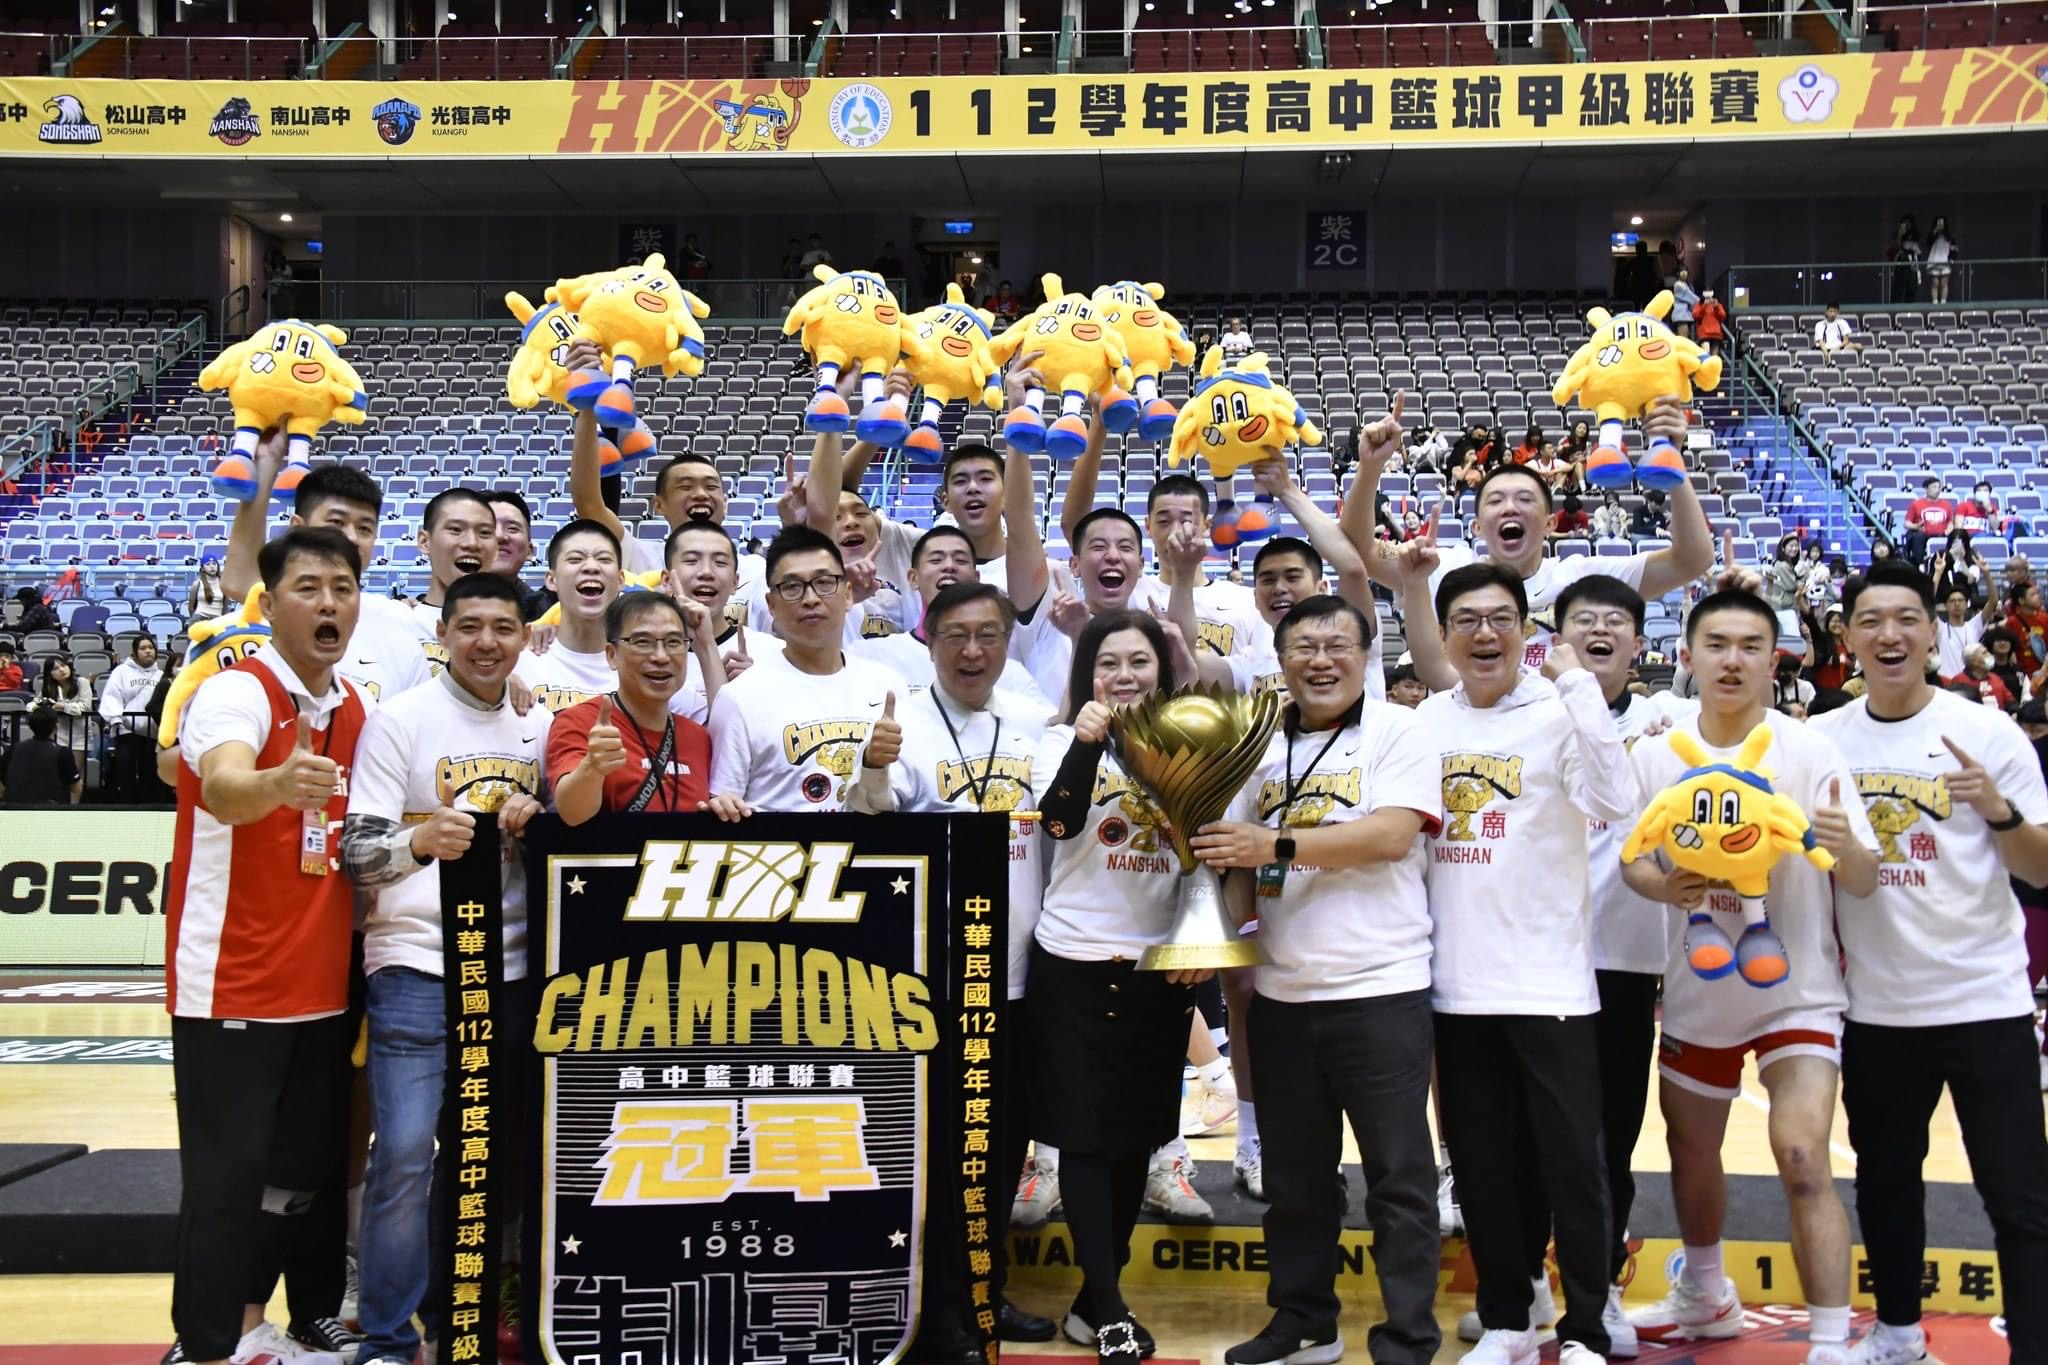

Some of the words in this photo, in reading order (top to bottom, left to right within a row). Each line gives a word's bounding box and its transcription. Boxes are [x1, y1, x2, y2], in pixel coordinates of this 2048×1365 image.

[0, 103, 28, 123] 中
[910, 69, 1760, 138] 112學年度高中籃球甲級聯賽
[105, 104, 187, 125] 松山高中
[271, 106, 350, 126] 南山高中
[431, 106, 511, 126] 光復高中
[106, 128, 150, 136] SONGSHAN
[210, 116, 260, 135] NANSHAN
[432, 129, 468, 137] KUANGFU
[1320, 215, 1352, 241] 紫
[1313, 244, 1358, 265] 2C
[1107, 854, 1170, 874] NANSHAN
[0, 860, 172, 915] CER
[532, 941, 940, 1053] CHAMPIONS
[618, 1064, 856, 1090] 高中籃球聯賽
[591, 1096, 881, 1206] 冠軍
[712, 1219, 773, 1233] EST.
[682, 1234, 796, 1259] 1988
